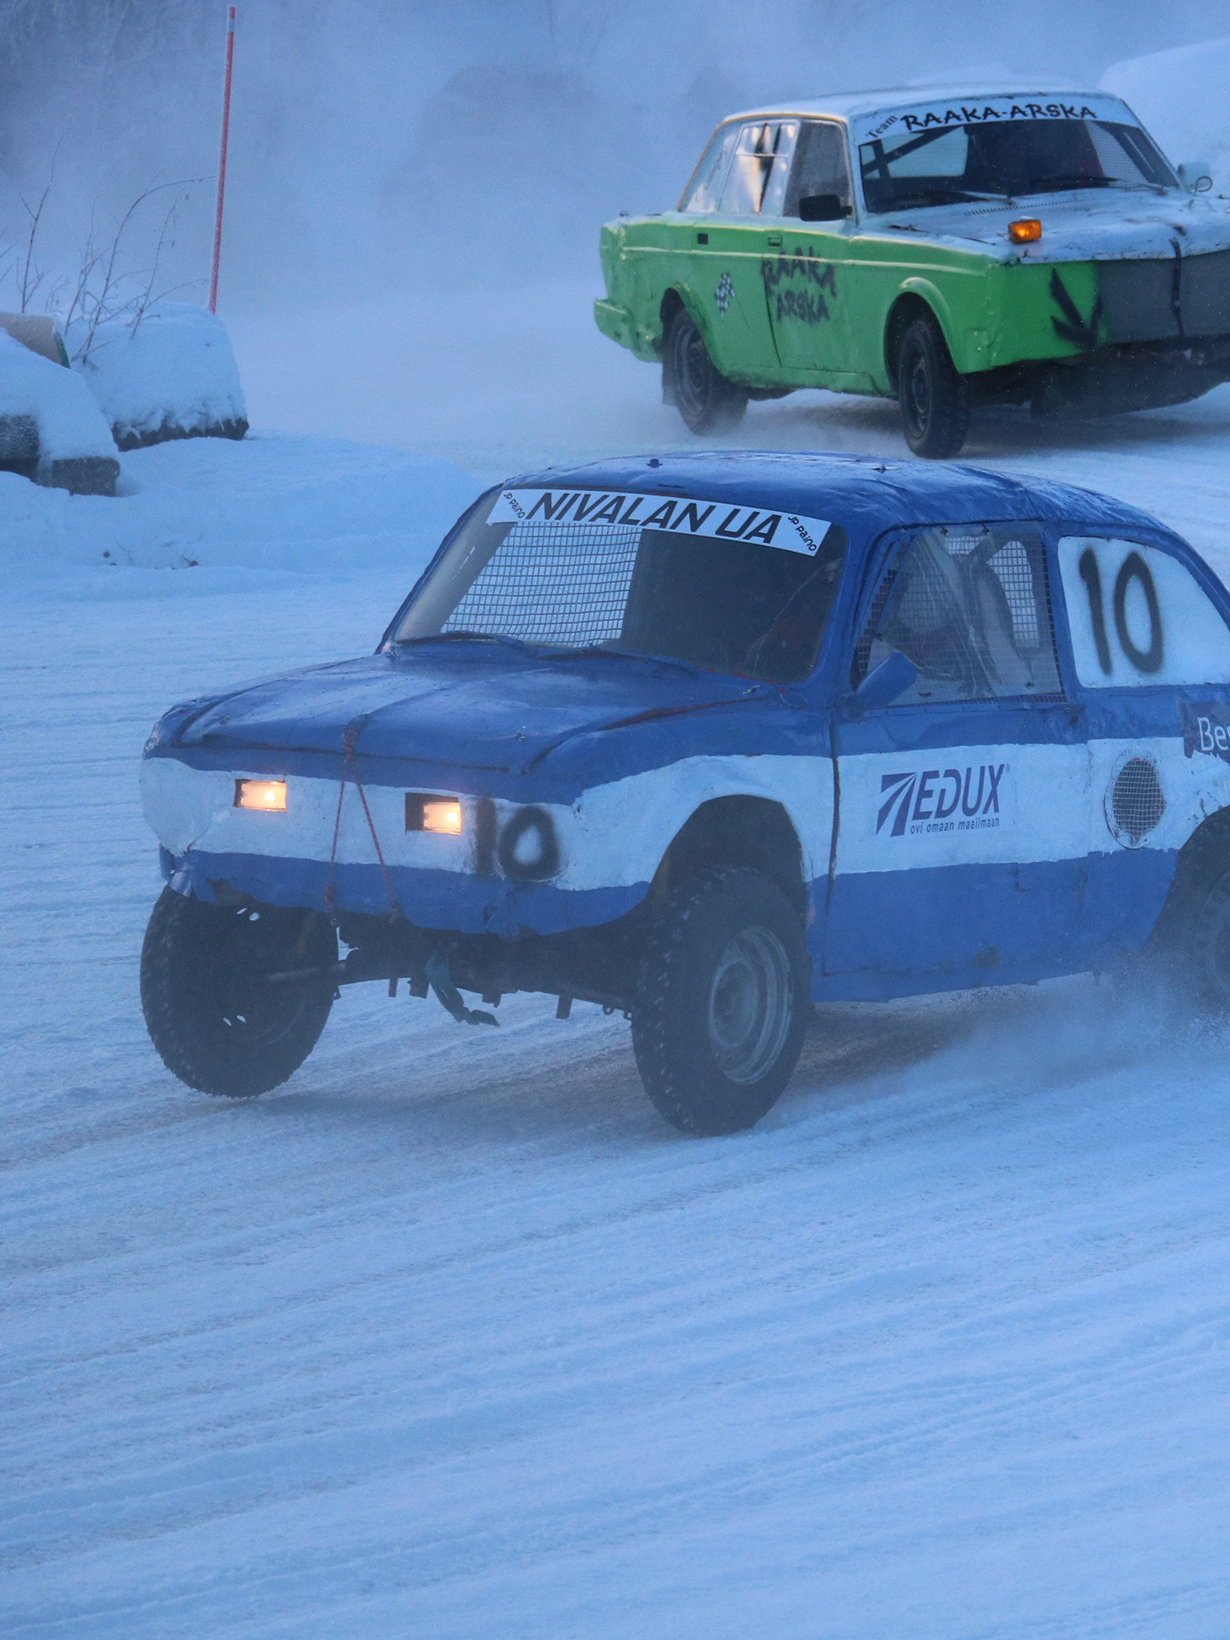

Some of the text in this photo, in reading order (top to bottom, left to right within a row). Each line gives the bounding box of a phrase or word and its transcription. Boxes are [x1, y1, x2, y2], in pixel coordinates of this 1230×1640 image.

[866, 102, 1098, 141] Team RAAKA-ARSKA
[760, 246, 838, 298] RAAKA
[776, 289, 831, 326] ARSKA
[525, 492, 783, 544] NIVALAN UA
[787, 516, 800, 525] JP
[1078, 547, 1165, 678] 10
[475, 795, 562, 892] 10
[910, 817, 1000, 835] ovi omaan maailmaan
